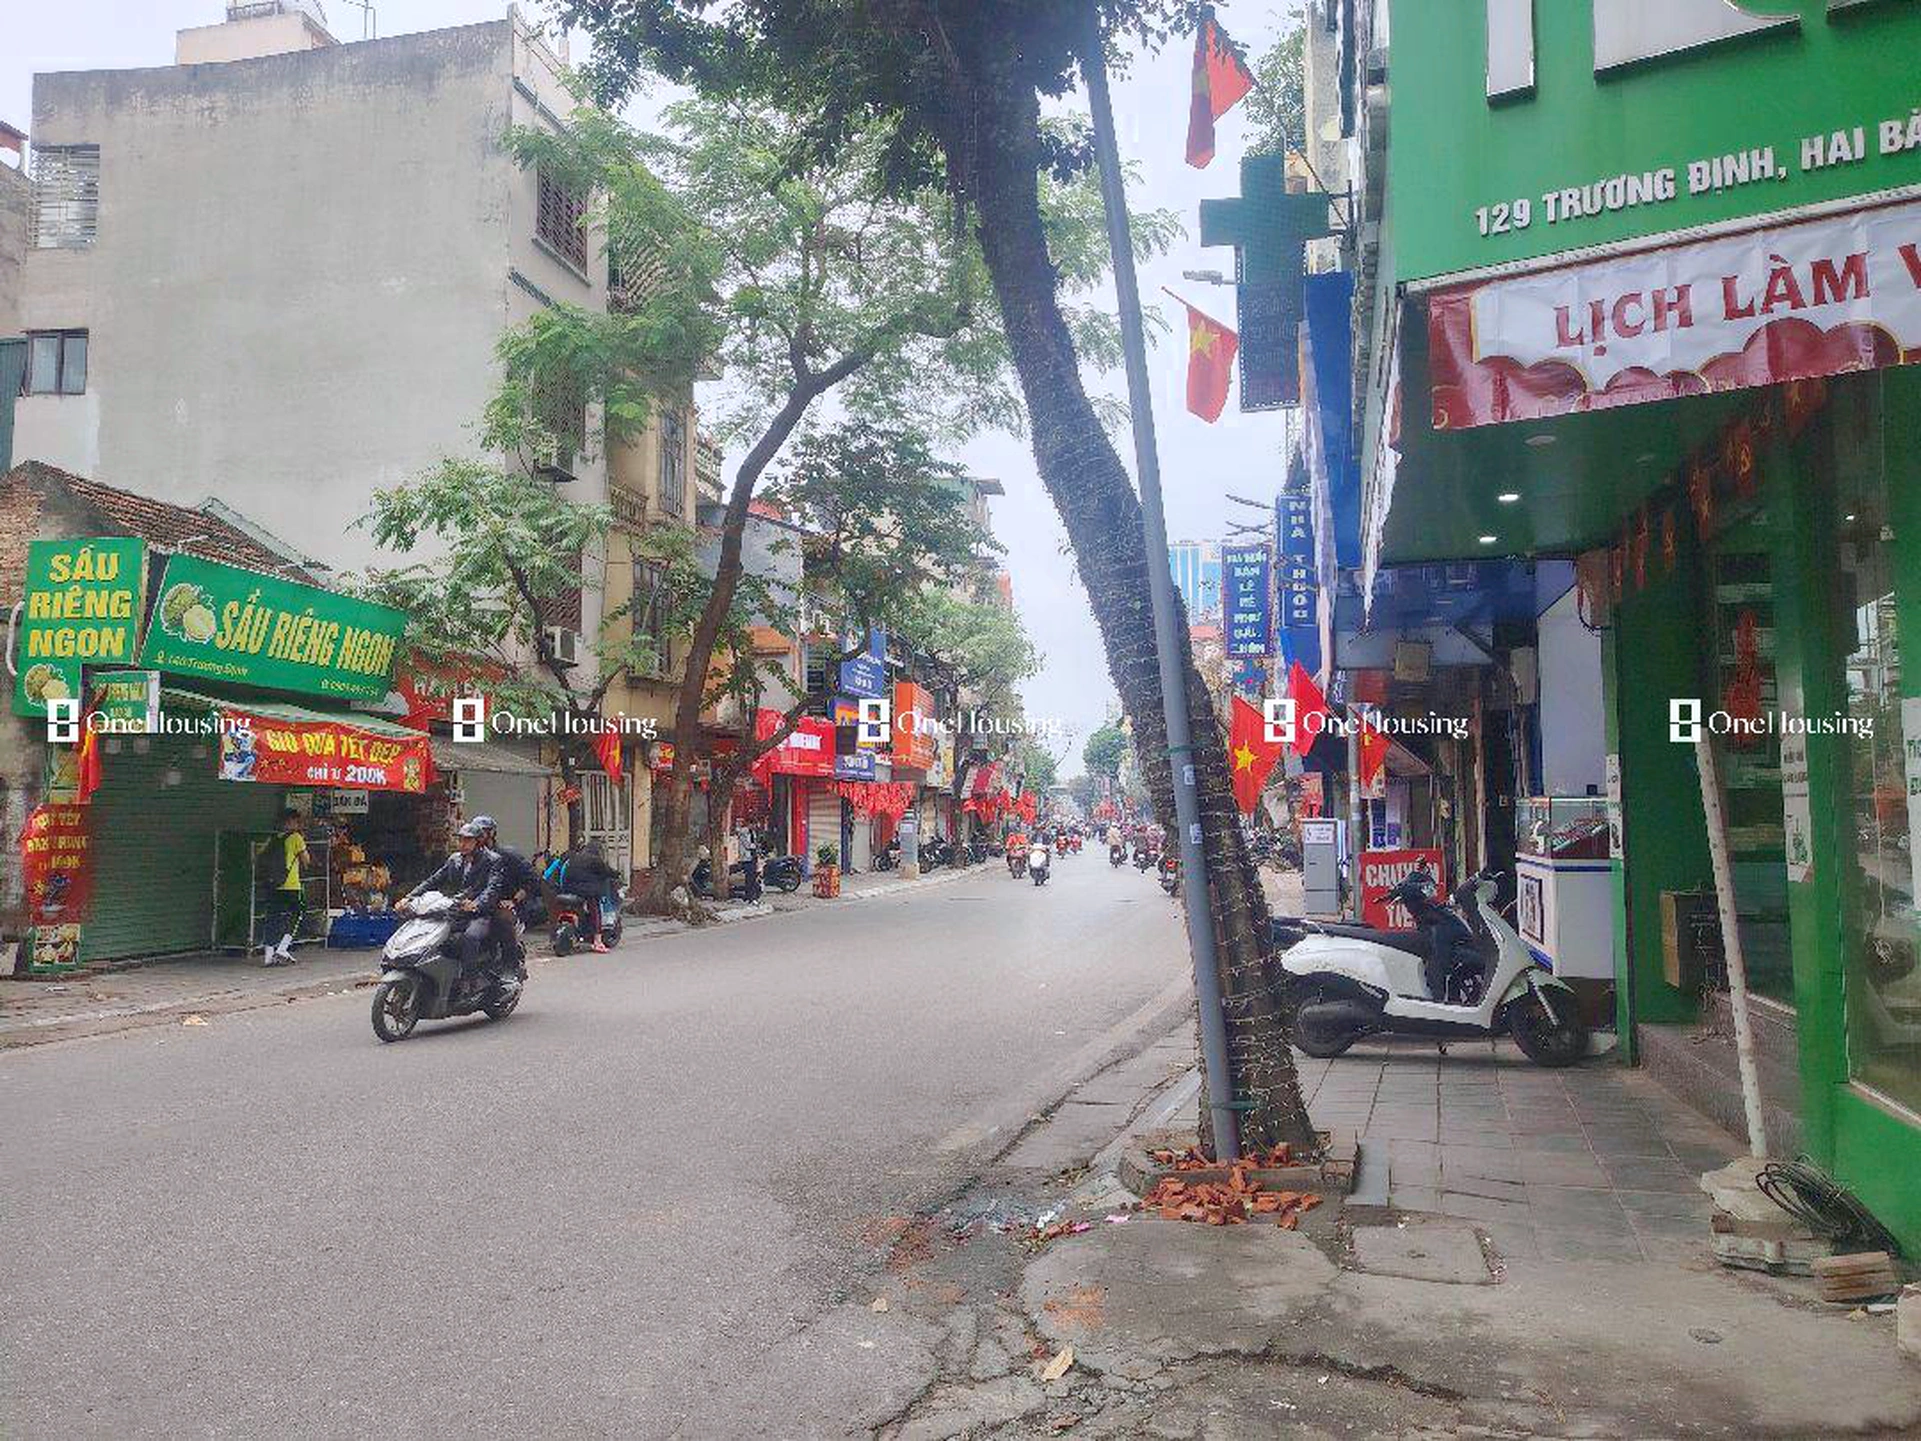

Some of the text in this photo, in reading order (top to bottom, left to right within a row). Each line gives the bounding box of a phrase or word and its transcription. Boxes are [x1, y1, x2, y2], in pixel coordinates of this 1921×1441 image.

[1475, 199, 1531, 235] 129
[1542, 168, 1675, 222] TRƯƠNG
[1688, 146, 1787, 194] ĐỊNH,
[1801, 126, 1865, 170] HAI
[1554, 284, 1694, 357] LỊCH
[1721, 251, 1871, 321] LÀM
[28, 584, 133, 619] RIÊNG
[28, 626, 126, 658] NGON
[267, 607, 340, 667] RIÊNG
[336, 625, 397, 678] NGON
[345, 764, 387, 786] 200K
